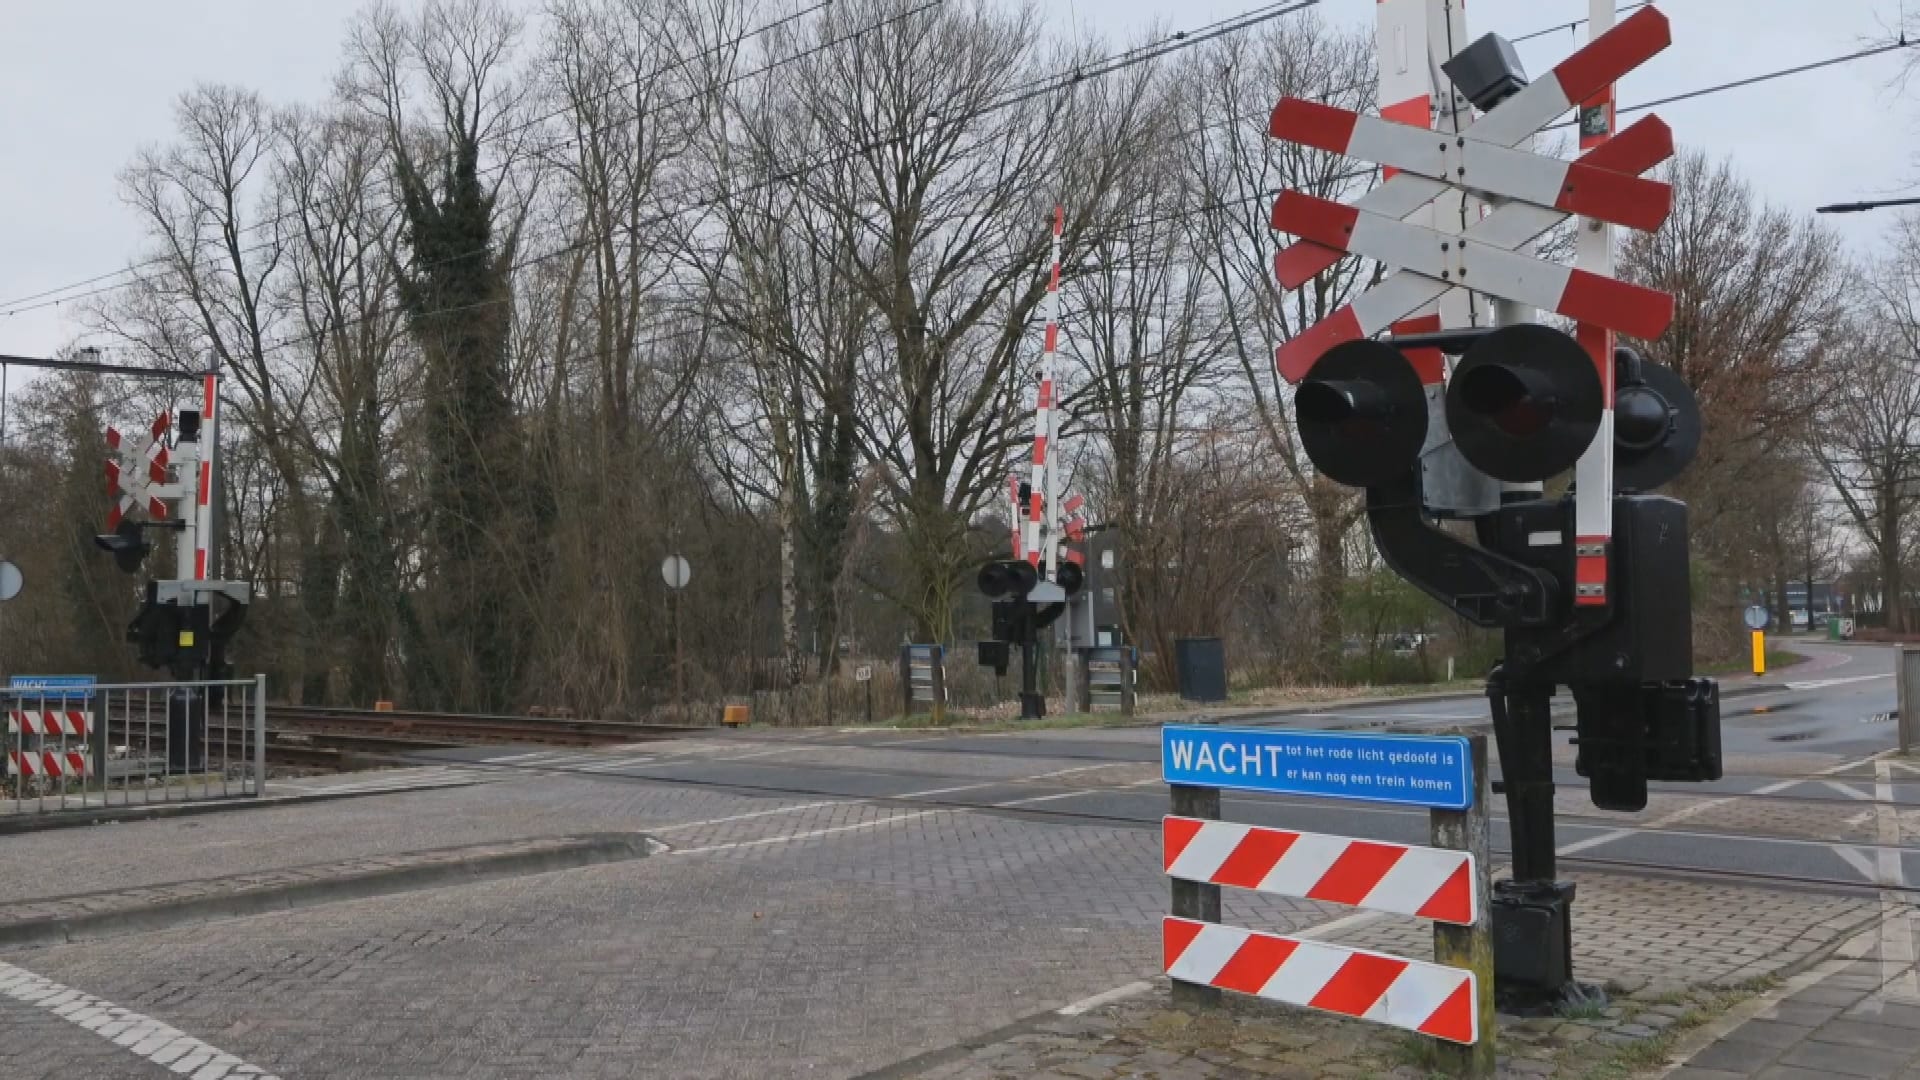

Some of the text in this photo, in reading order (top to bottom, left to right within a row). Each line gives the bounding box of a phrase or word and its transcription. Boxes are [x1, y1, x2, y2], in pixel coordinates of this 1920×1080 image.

[1170, 740, 1282, 777] WACHT
[1286, 745, 1454, 765] tot het rode licht gedoofd is
[1287, 769, 1452, 791] er kan nog een trein komen
